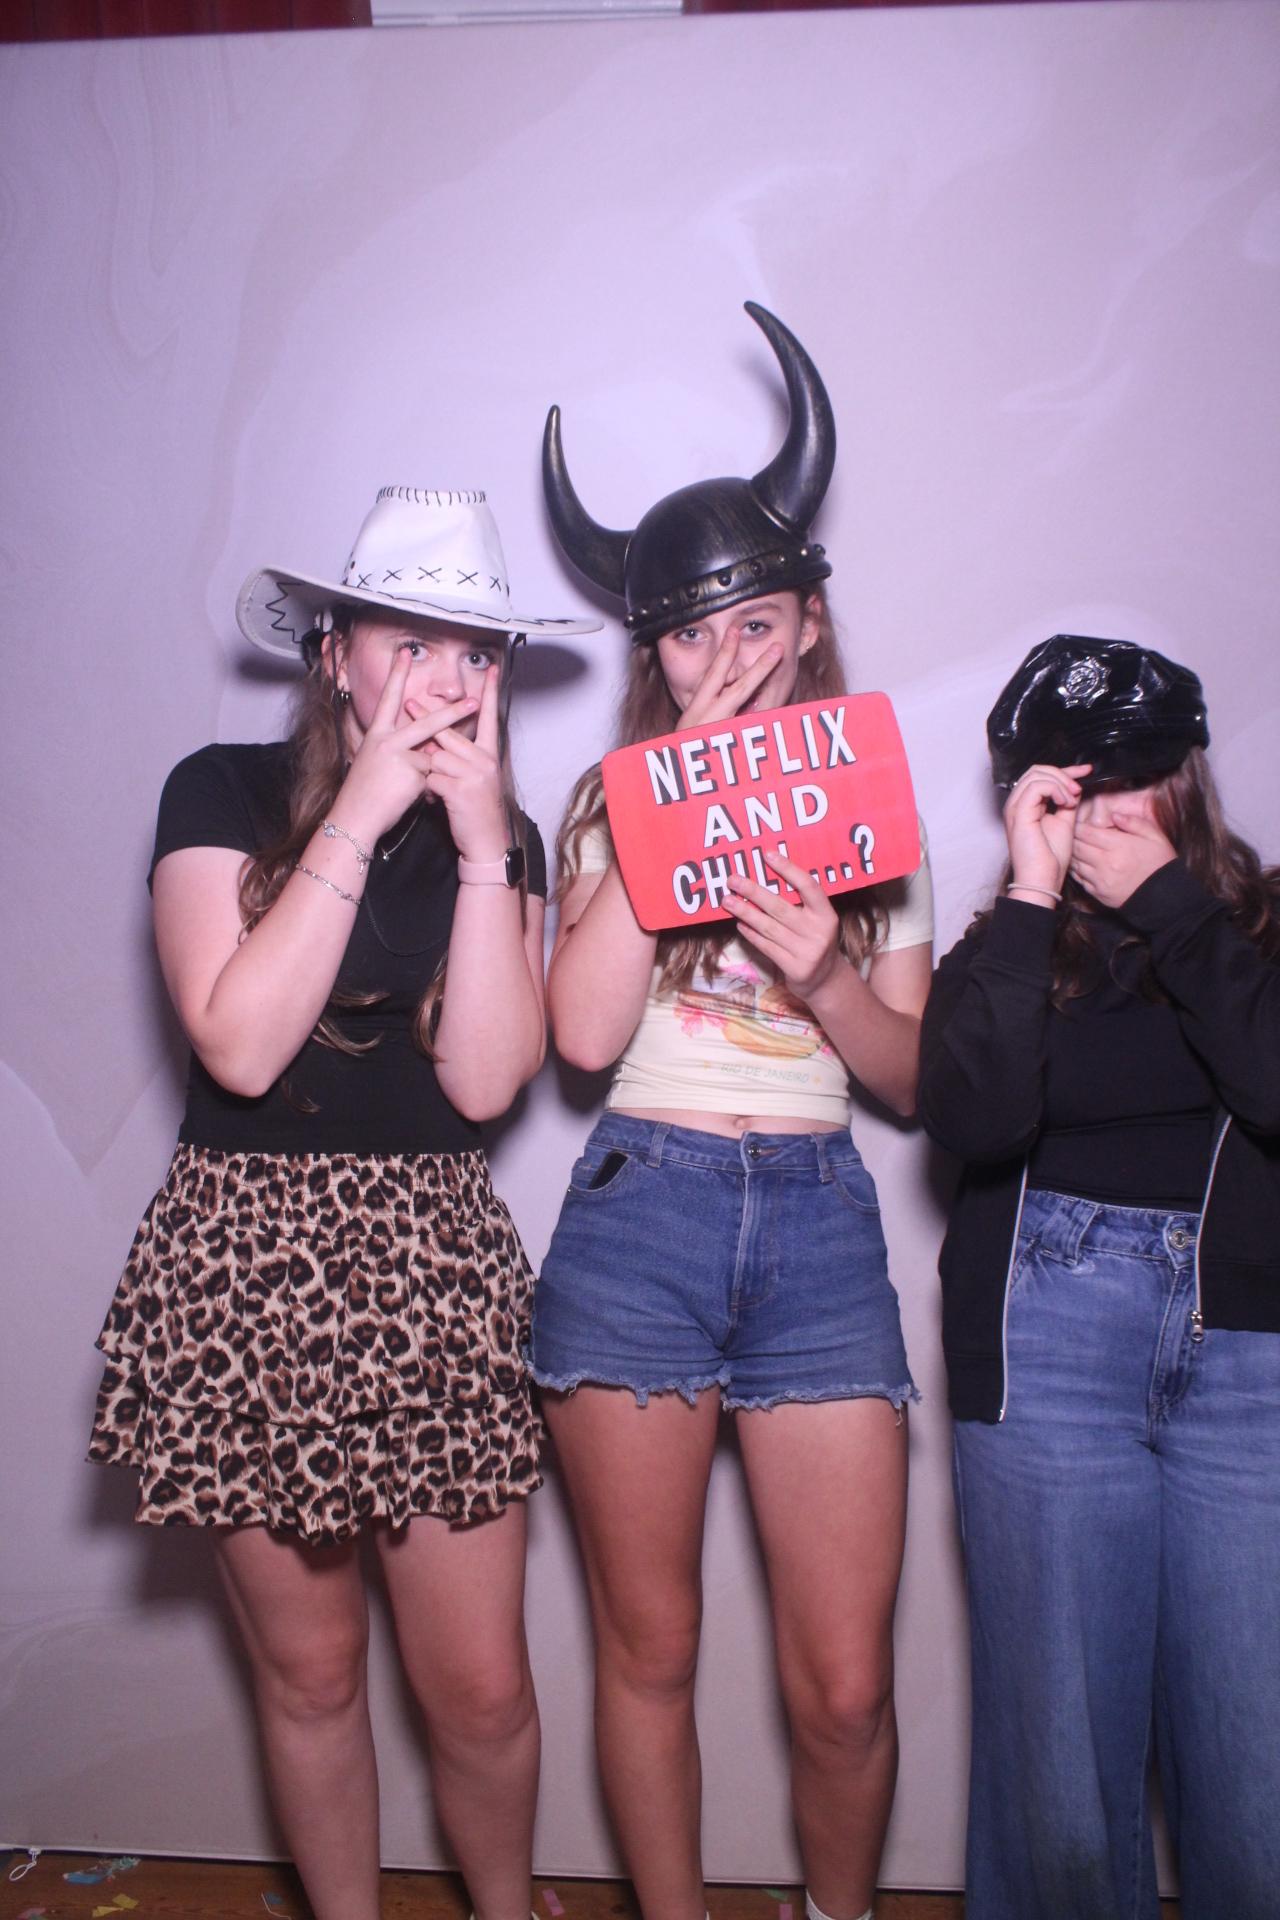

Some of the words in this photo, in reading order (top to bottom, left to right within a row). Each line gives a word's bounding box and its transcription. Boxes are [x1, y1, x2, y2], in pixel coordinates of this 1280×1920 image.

[644, 706, 856, 805] NETFLIX
[704, 784, 829, 848] AND
[745, 1064, 761, 1077] DE
[764, 1067, 810, 1084] JANEIRO
